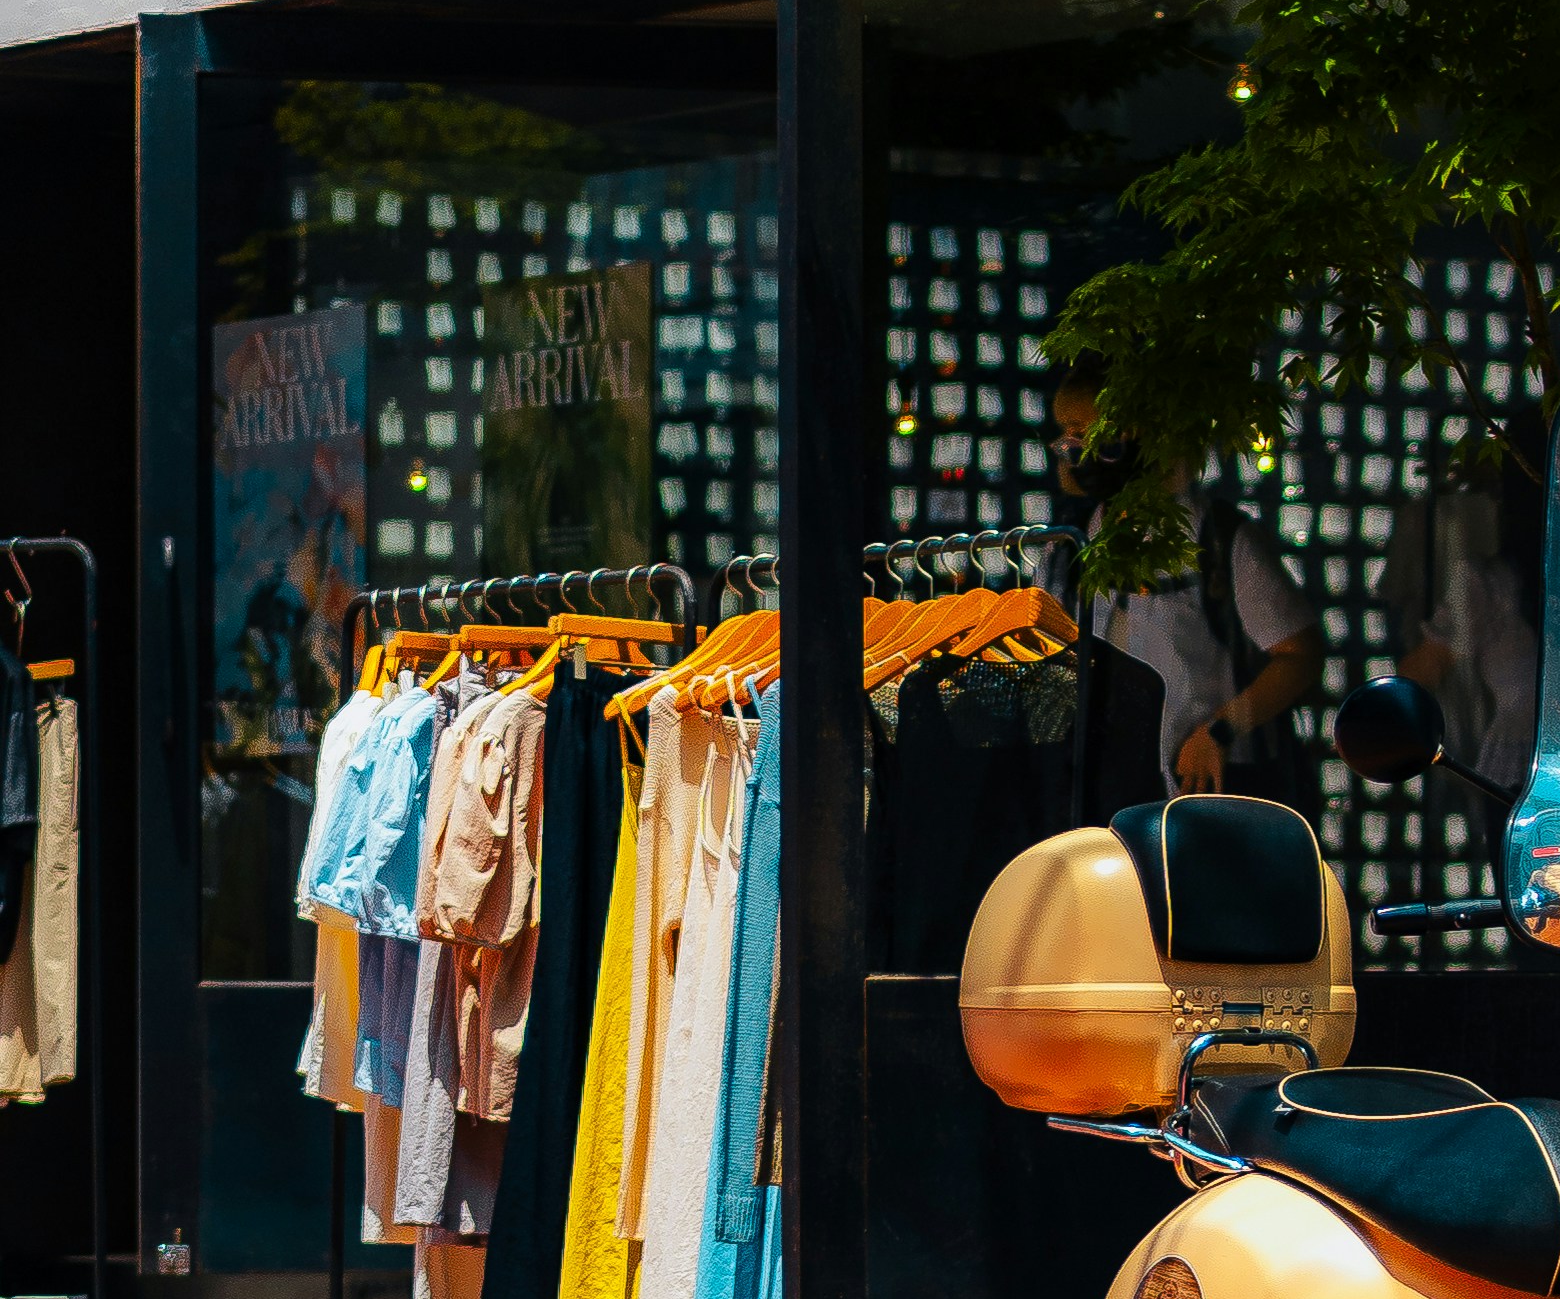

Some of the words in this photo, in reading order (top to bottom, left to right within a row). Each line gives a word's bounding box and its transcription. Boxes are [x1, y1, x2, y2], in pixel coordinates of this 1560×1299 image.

[526, 280, 624, 349] NEW
[249, 321, 335, 387] NEW
[489, 339, 645, 412] ARRIVAL
[217, 377, 360, 448] ARRIVAL
